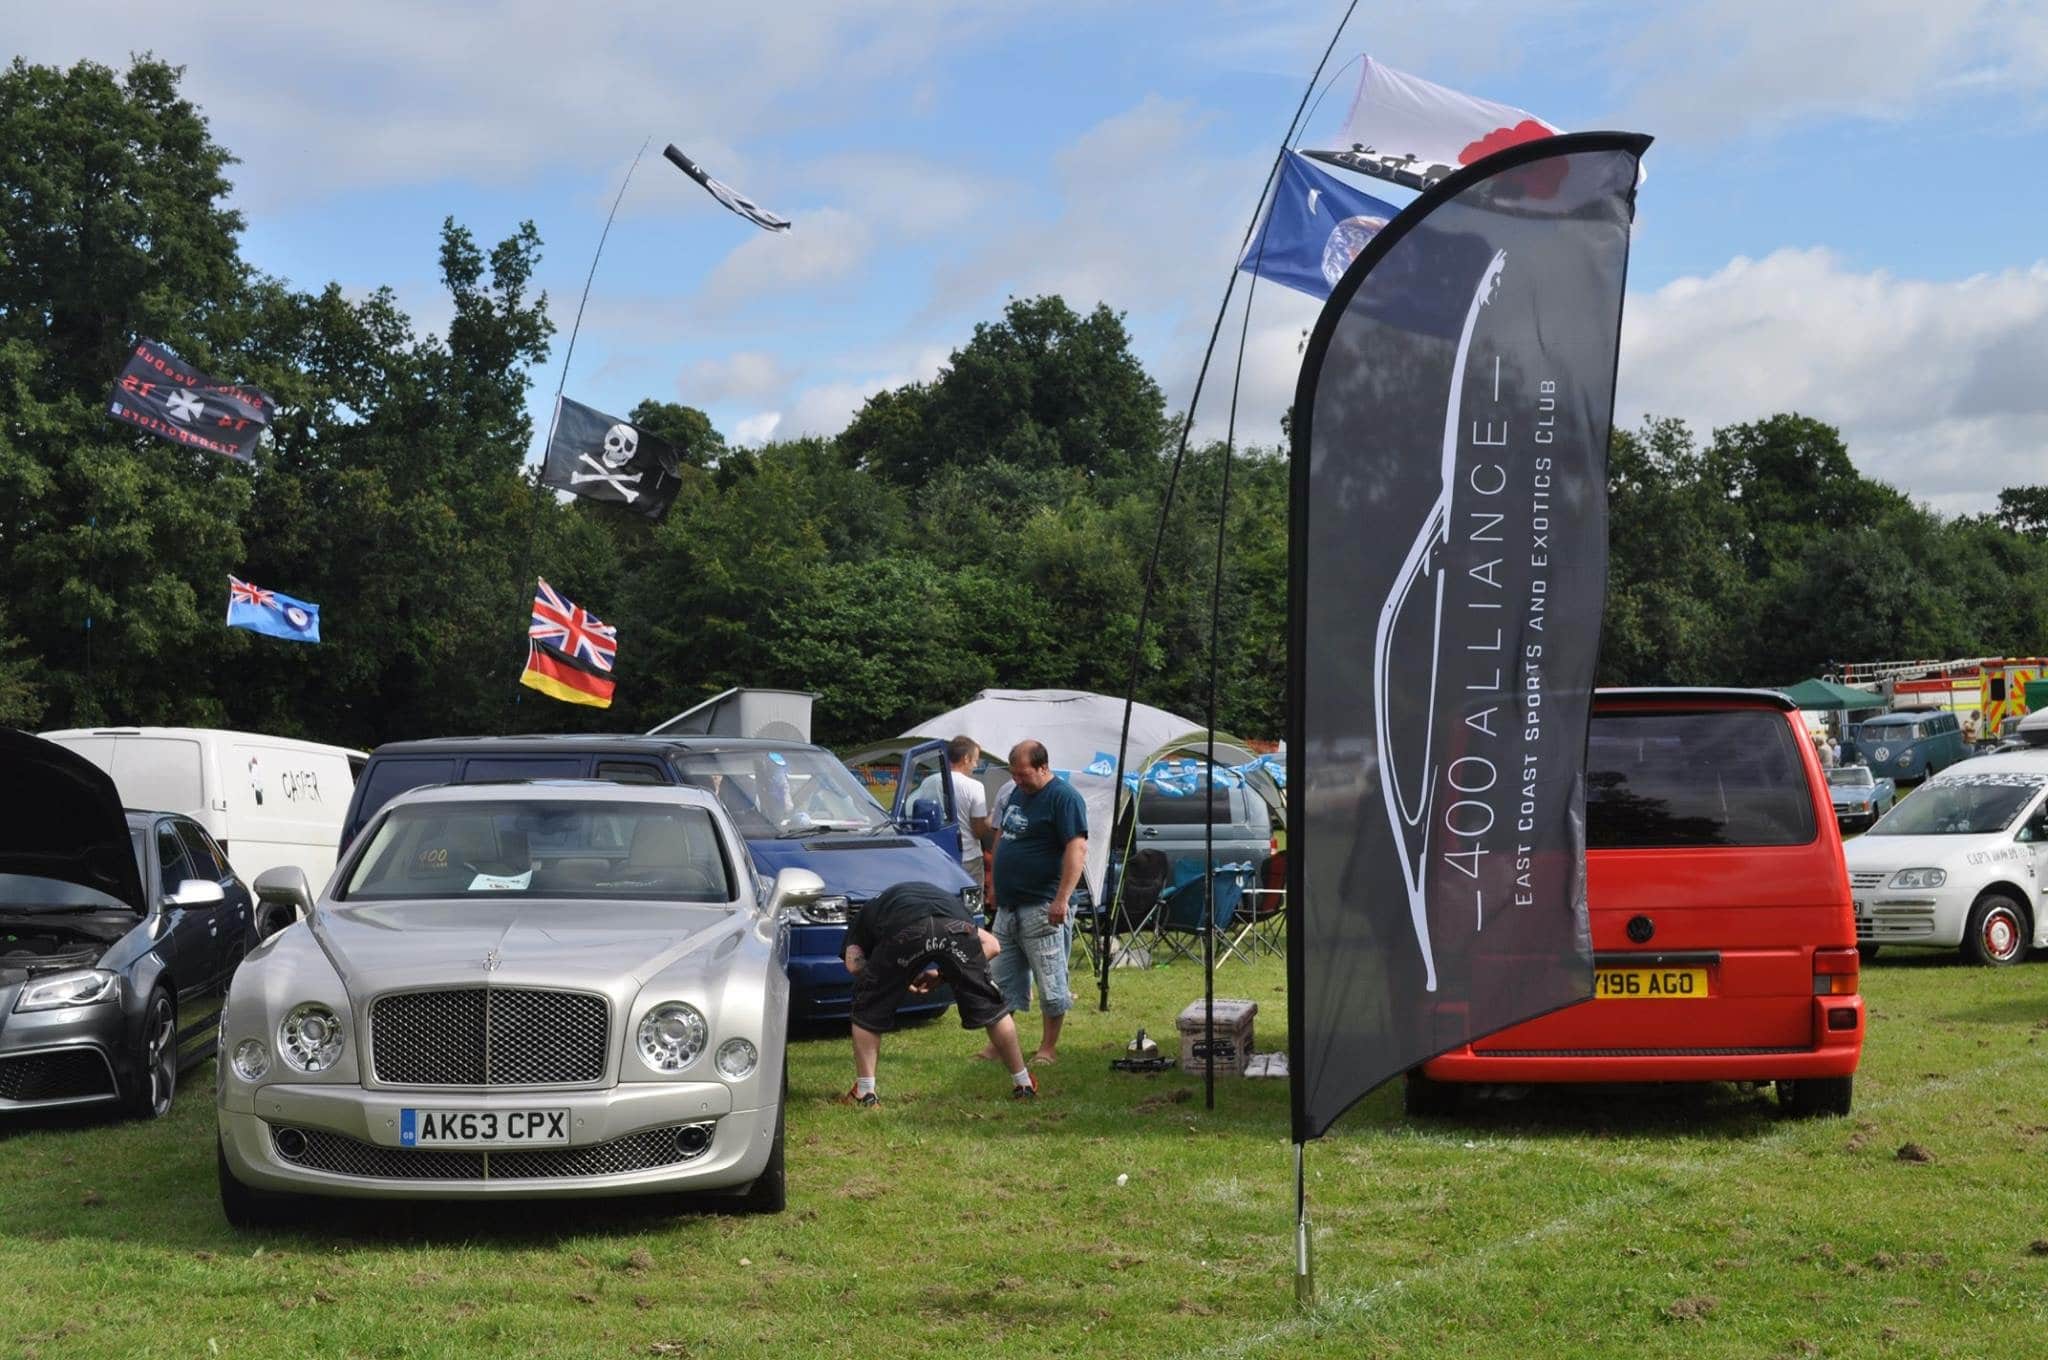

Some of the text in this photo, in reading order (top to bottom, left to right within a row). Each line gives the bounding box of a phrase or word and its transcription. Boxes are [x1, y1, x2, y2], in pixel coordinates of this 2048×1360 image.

[1444, 421, 1508, 880] 400 ALLIANCE
[1515, 380, 1556, 906] EAST COAST SPORTS AND EXOTICS CLUB
[1648, 973, 1693, 995] AGO
[421, 1112, 565, 1140] AK63 CPX
